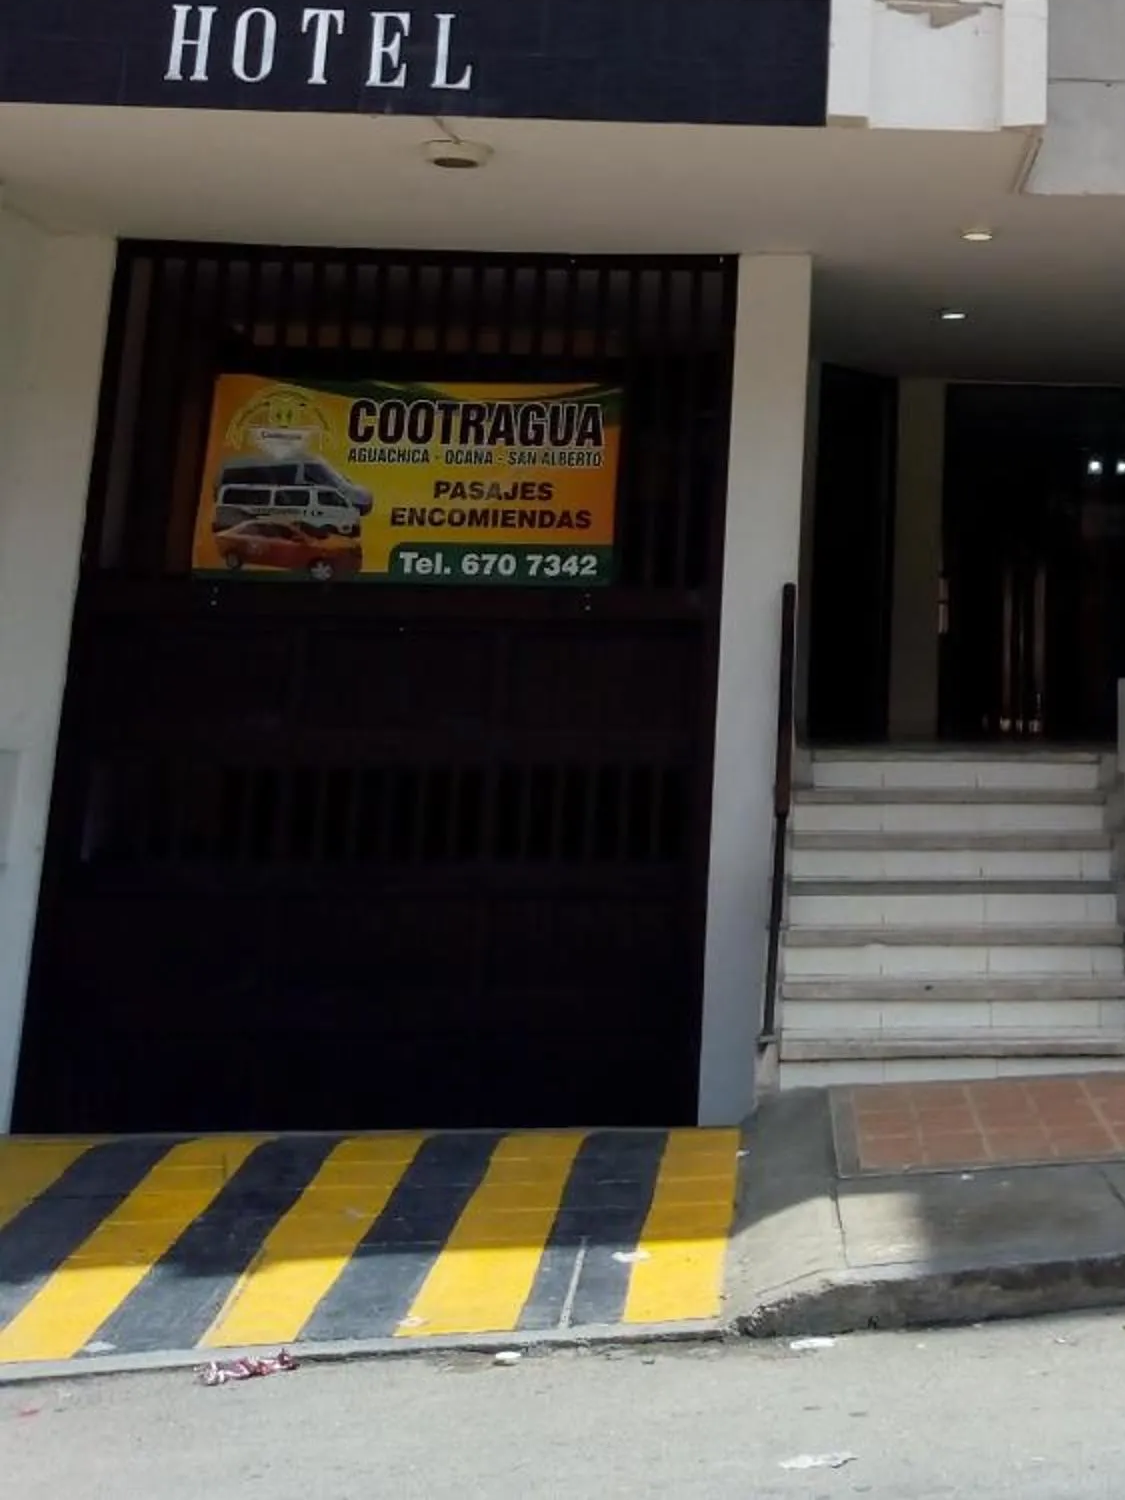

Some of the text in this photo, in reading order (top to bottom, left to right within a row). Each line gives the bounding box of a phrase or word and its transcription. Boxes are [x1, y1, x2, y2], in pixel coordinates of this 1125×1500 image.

[163, 3, 473, 90] HOTEL
[347, 398, 605, 448] COOTRAGUA
[348, 448, 430, 465] AGUACHICA
[507, 451, 537, 467] SAN
[540, 451, 604, 468] ALBERTO
[433, 480, 553, 501] PASAJES
[390, 507, 592, 529] ENCOMIENDAS
[400, 552, 597, 577] Tel. 670 7342
